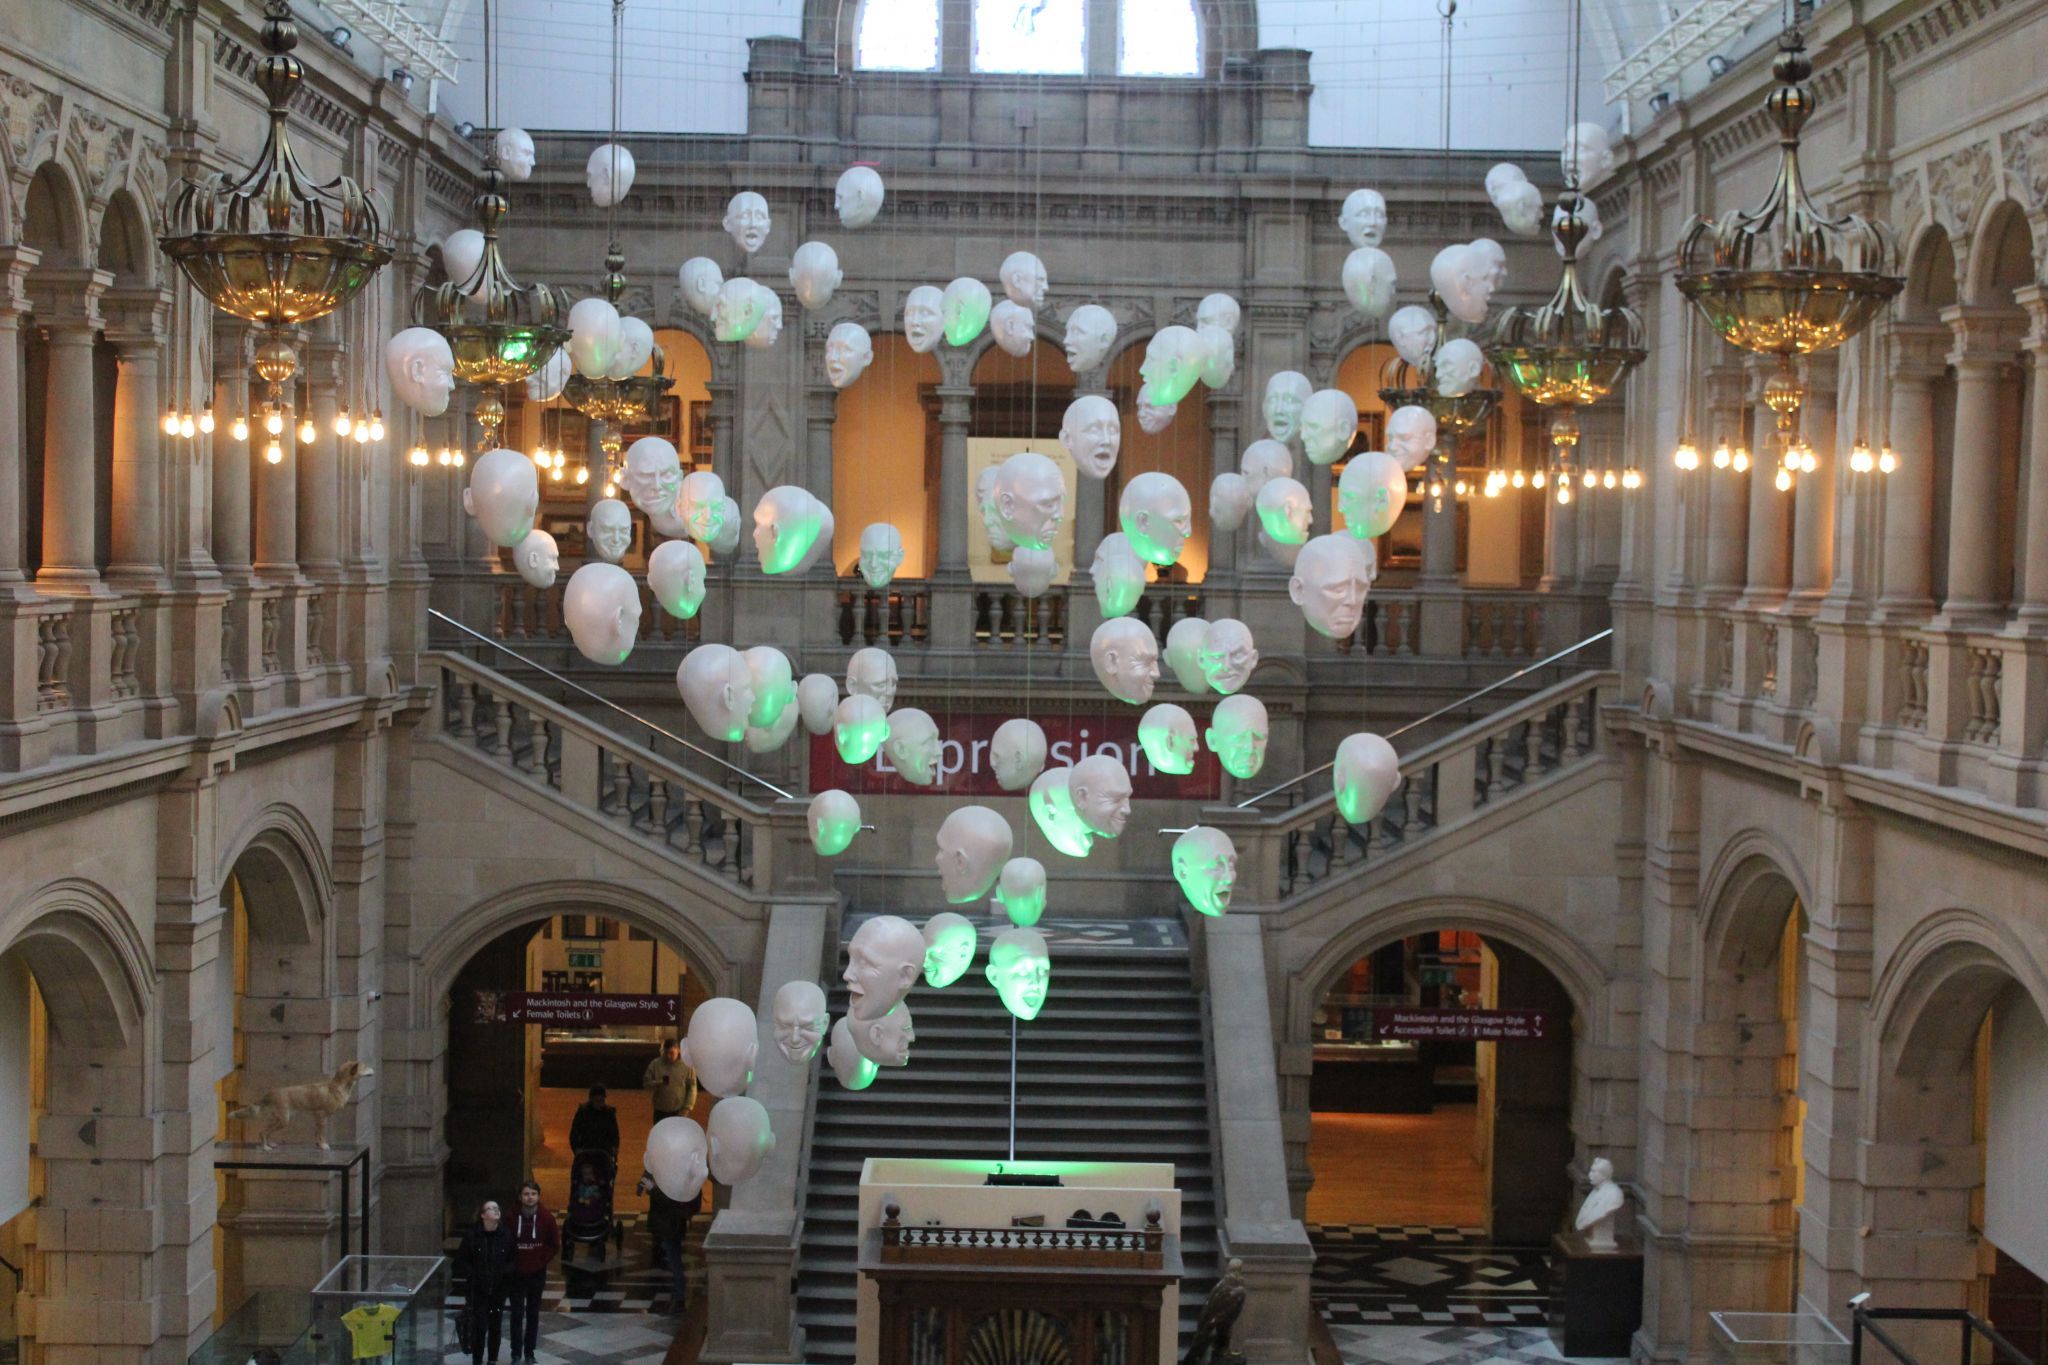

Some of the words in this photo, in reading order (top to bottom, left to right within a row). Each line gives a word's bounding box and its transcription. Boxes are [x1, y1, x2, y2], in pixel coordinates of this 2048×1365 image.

[526, 998, 571, 1007] Mackintosh
[573, 999, 588, 1007] and
[589, 999, 603, 1008] the
[604, 999, 637, 1009] Glasgow
[639, 1000, 659, 1010] Style
[526, 1010, 554, 1018] Female
[556, 1011, 581, 1019] Toilets
[1393, 1014, 1438, 1023] Mackintosh
[1440, 1014, 1455, 1023] and
[1456, 1014, 1469, 1024] the
[1471, 1015, 1504, 1025] Glasgow
[1506, 1015, 1525, 1025] Style
[1393, 1026, 1434, 1034] Accessible
[1435, 1026, 1456, 1035] Toilet
[1482, 1028, 1502, 1036] Male
[1504, 1028, 1528, 1036] Toilets
